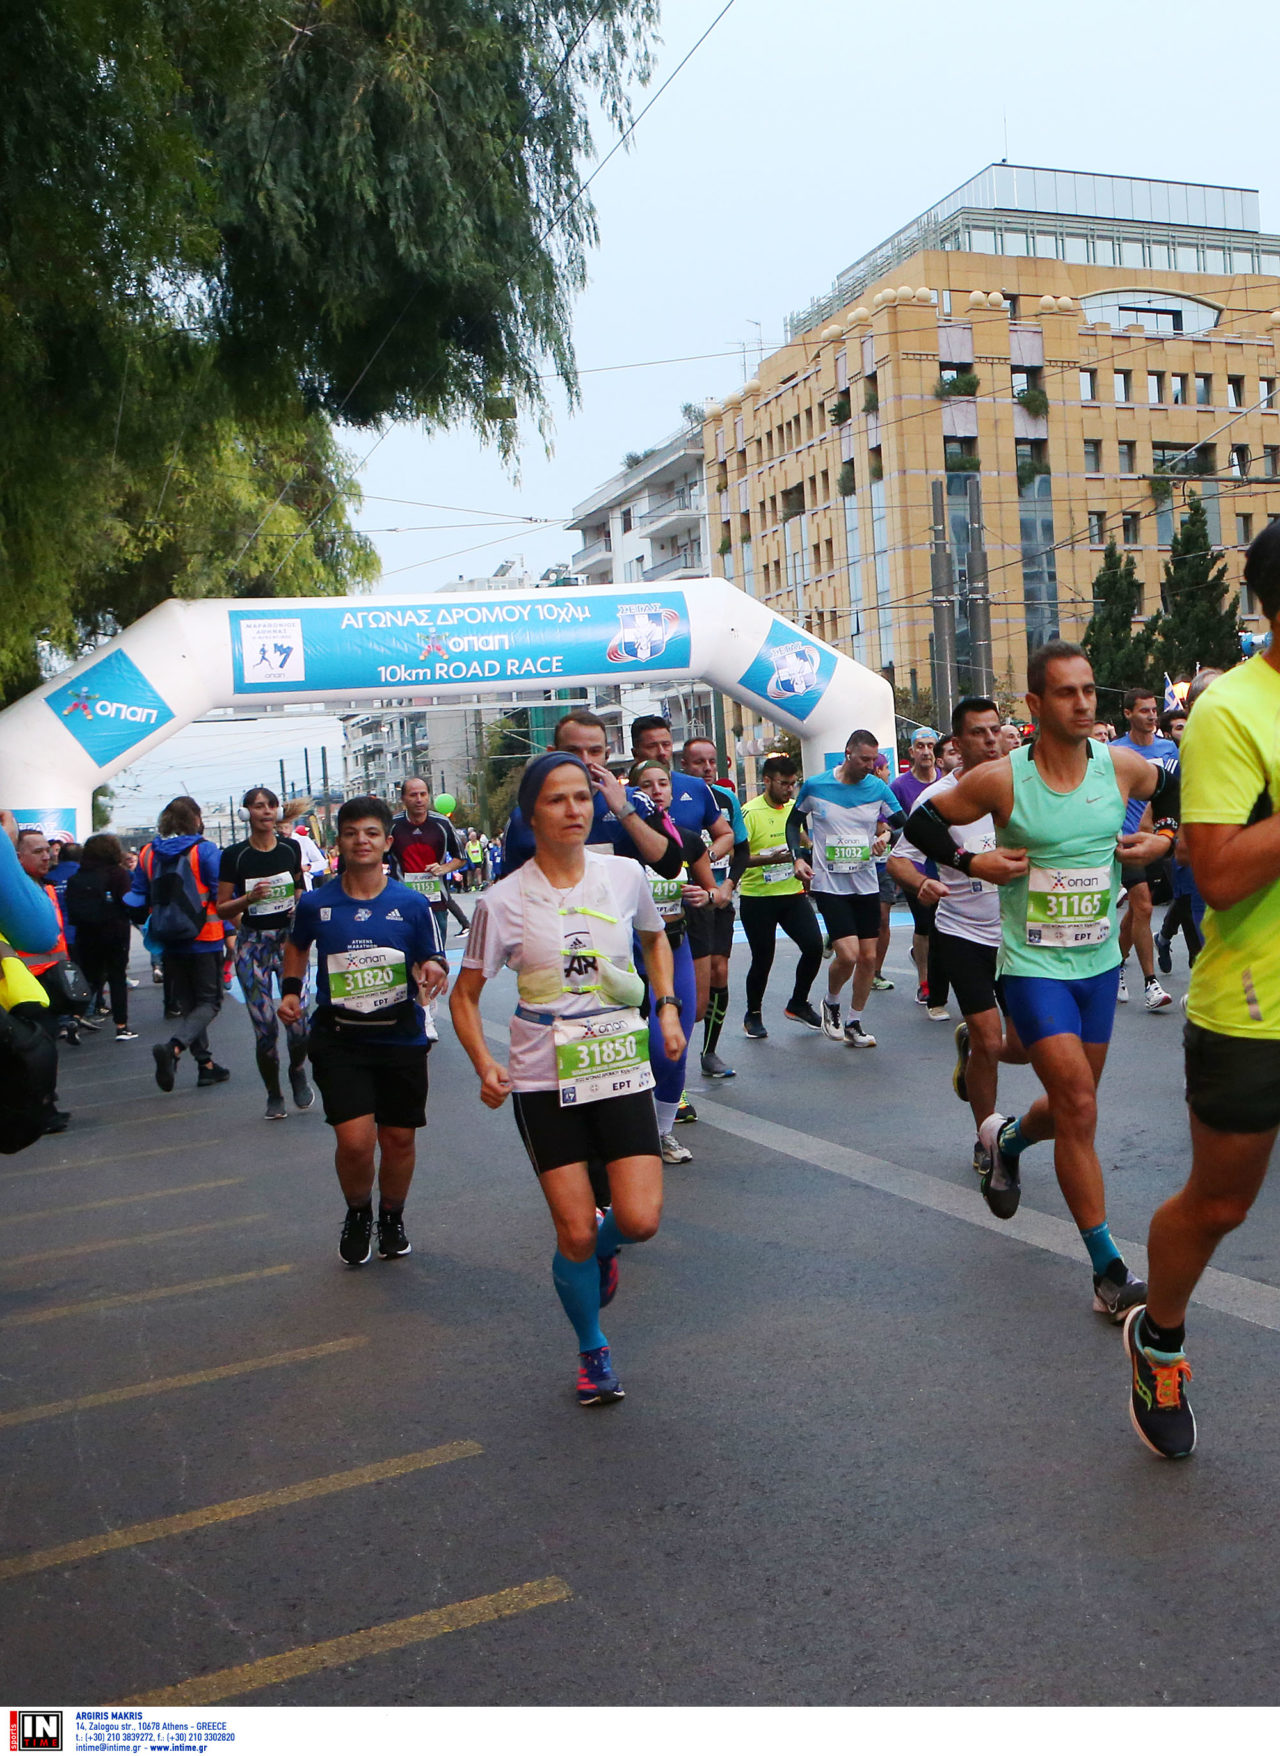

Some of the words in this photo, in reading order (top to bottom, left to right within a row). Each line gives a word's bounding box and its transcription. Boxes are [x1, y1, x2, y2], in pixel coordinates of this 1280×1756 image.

[341, 609, 432, 629] ΑΓΩΝΑΣ
[436, 605, 532, 625] ΔΡΟΜΟΥ
[534, 603, 591, 622] 10χλμ
[377, 664, 431, 683] 10km
[435, 660, 500, 680] ROAD
[507, 656, 563, 675] RACE
[835, 847, 862, 858] 31032
[1046, 894, 1102, 916] 31165
[344, 967, 394, 991] 31820
[576, 1035, 637, 1068] 31850
